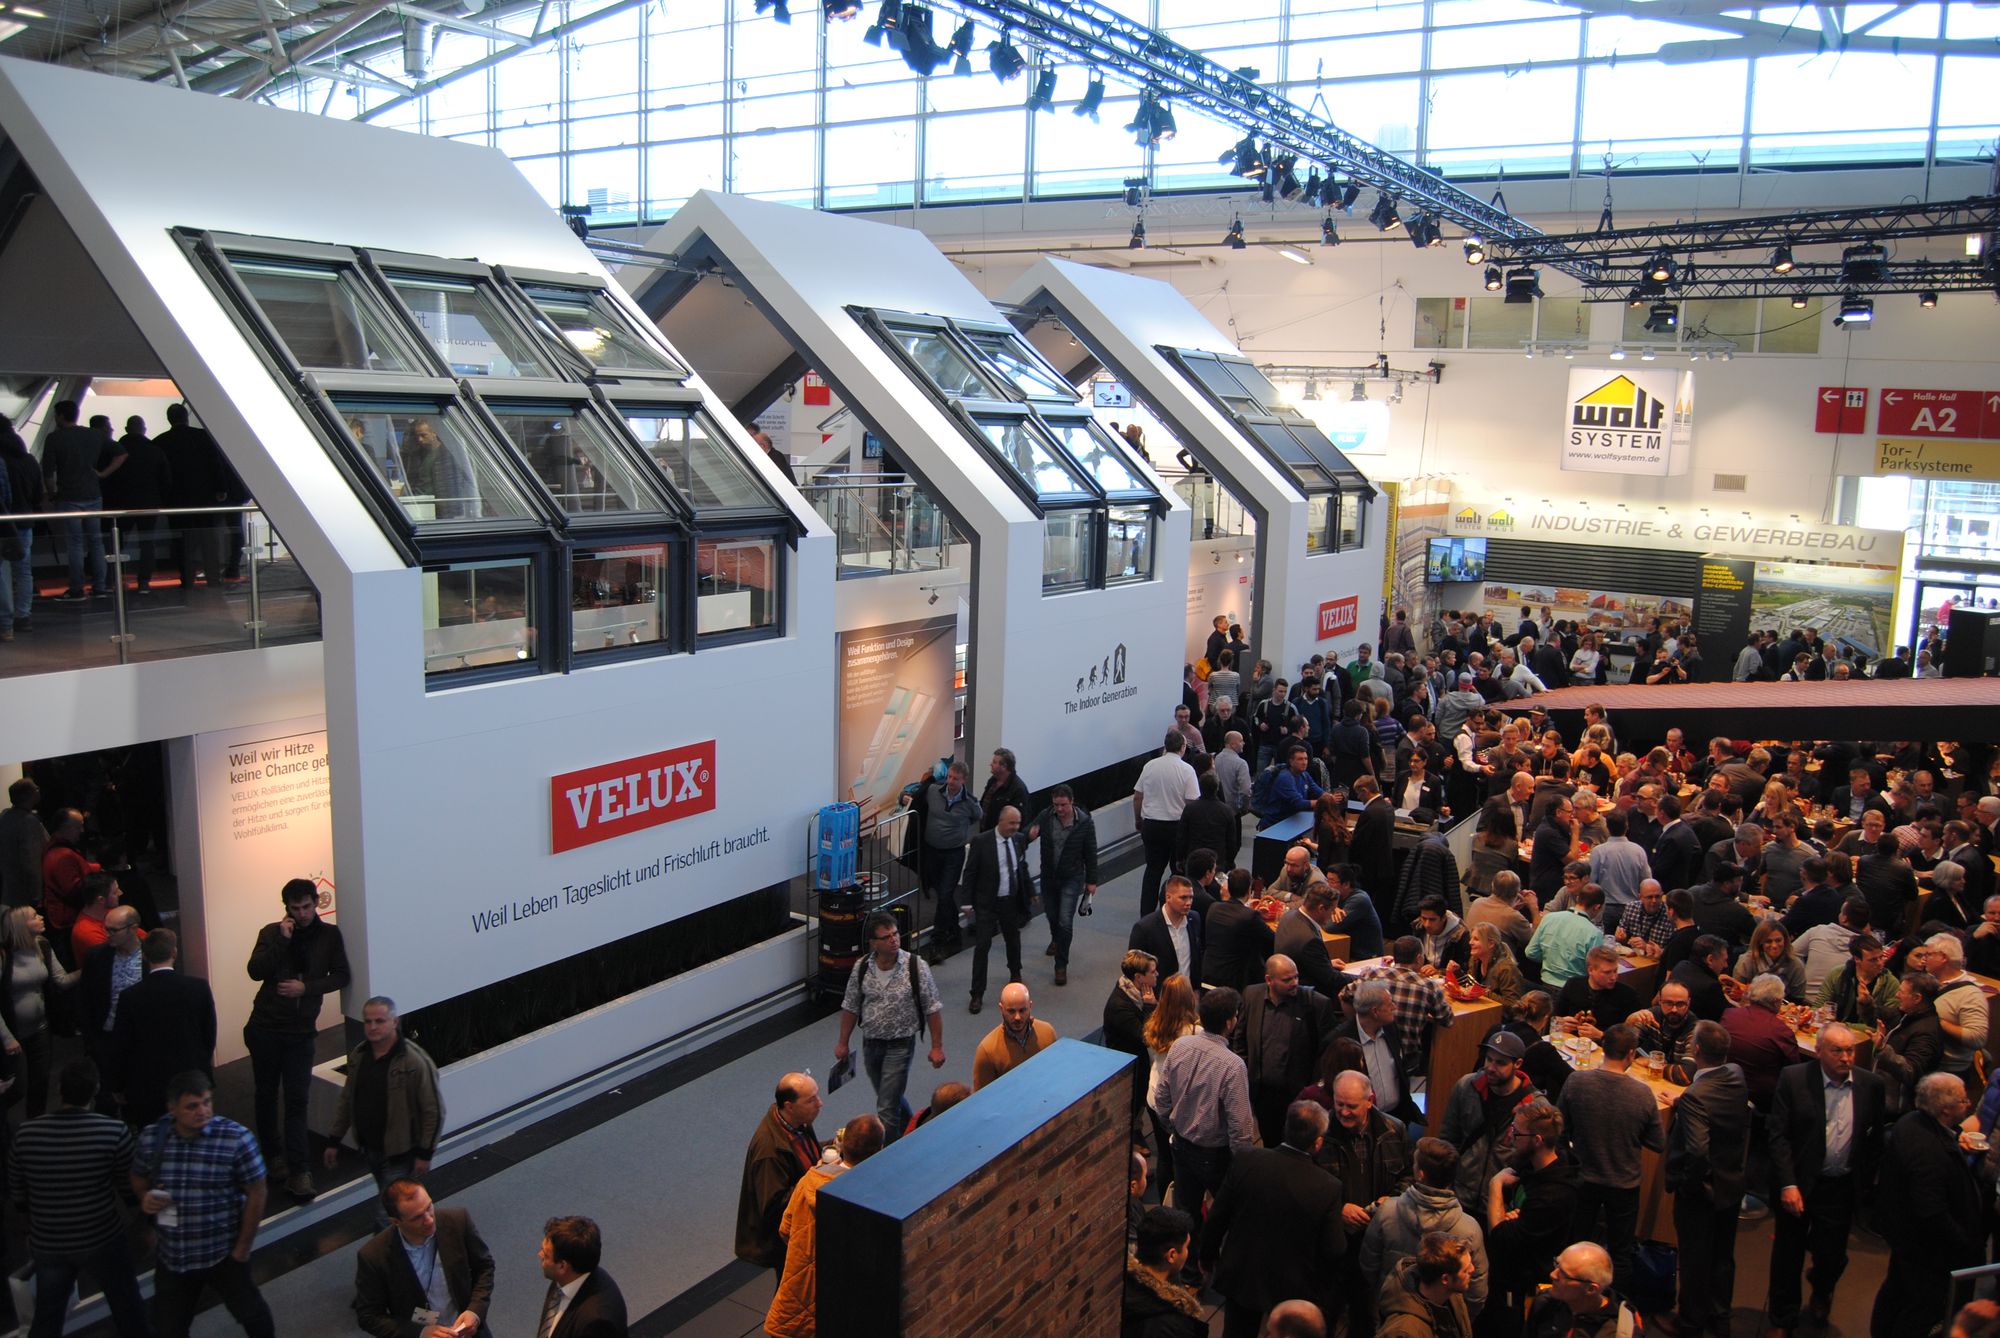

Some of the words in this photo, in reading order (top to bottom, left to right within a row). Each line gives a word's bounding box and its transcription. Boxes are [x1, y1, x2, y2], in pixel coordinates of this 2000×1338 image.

[1573, 387, 1665, 429] wolf
[1913, 392, 1936, 401] Halle
[1938, 393, 1957, 401] Hall
[1911, 407, 1957, 433] A2
[1571, 431, 1661, 450] SYSTEM
[1881, 443, 1912, 456] Tor-
[1916, 443, 1925, 459] /
[1568, 451, 1661, 463] www.wolfsystem.de
[1880, 456, 1973, 474] Parksysteme
[1455, 511, 1482, 524] wolf
[1531, 514, 1662, 537] INDUSTRIE-
[1667, 522, 1683, 539] &
[1693, 525, 1877, 552] GEWERBEBAU
[1321, 603, 1355, 631] VELUX
[848, 646, 860, 656] Weil
[861, 642, 885, 654] Funktion
[886, 640, 896, 650] und
[896, 638, 914, 648] Design
[847, 651, 898, 667] zusammengehören.
[1064, 700, 1078, 714] The
[1079, 696, 1101, 710] Indoor
[1102, 686, 1138, 704] Generation
[229, 750, 257, 767] Weil
[261, 748, 280, 761] wir
[284, 743, 315, 758] Hitze
[230, 769, 262, 784] keine
[265, 760, 309, 778] Chance
[232, 788, 260, 802] VELUX
[296, 778, 310, 789] und
[232, 799, 278, 816] ermöglichen
[232, 818, 245, 828] der
[247, 814, 268, 826] Hitze
[268, 809, 283, 818] und
[285, 805, 310, 816] sorgen
[472, 904, 508, 934] Weil
[513, 892, 558, 922] Leben
[563, 868, 632, 905] Tageslicht
[636, 858, 660, 883] und
[664, 841, 721, 874] Frischluft
[723, 825, 770, 856] braucht.
